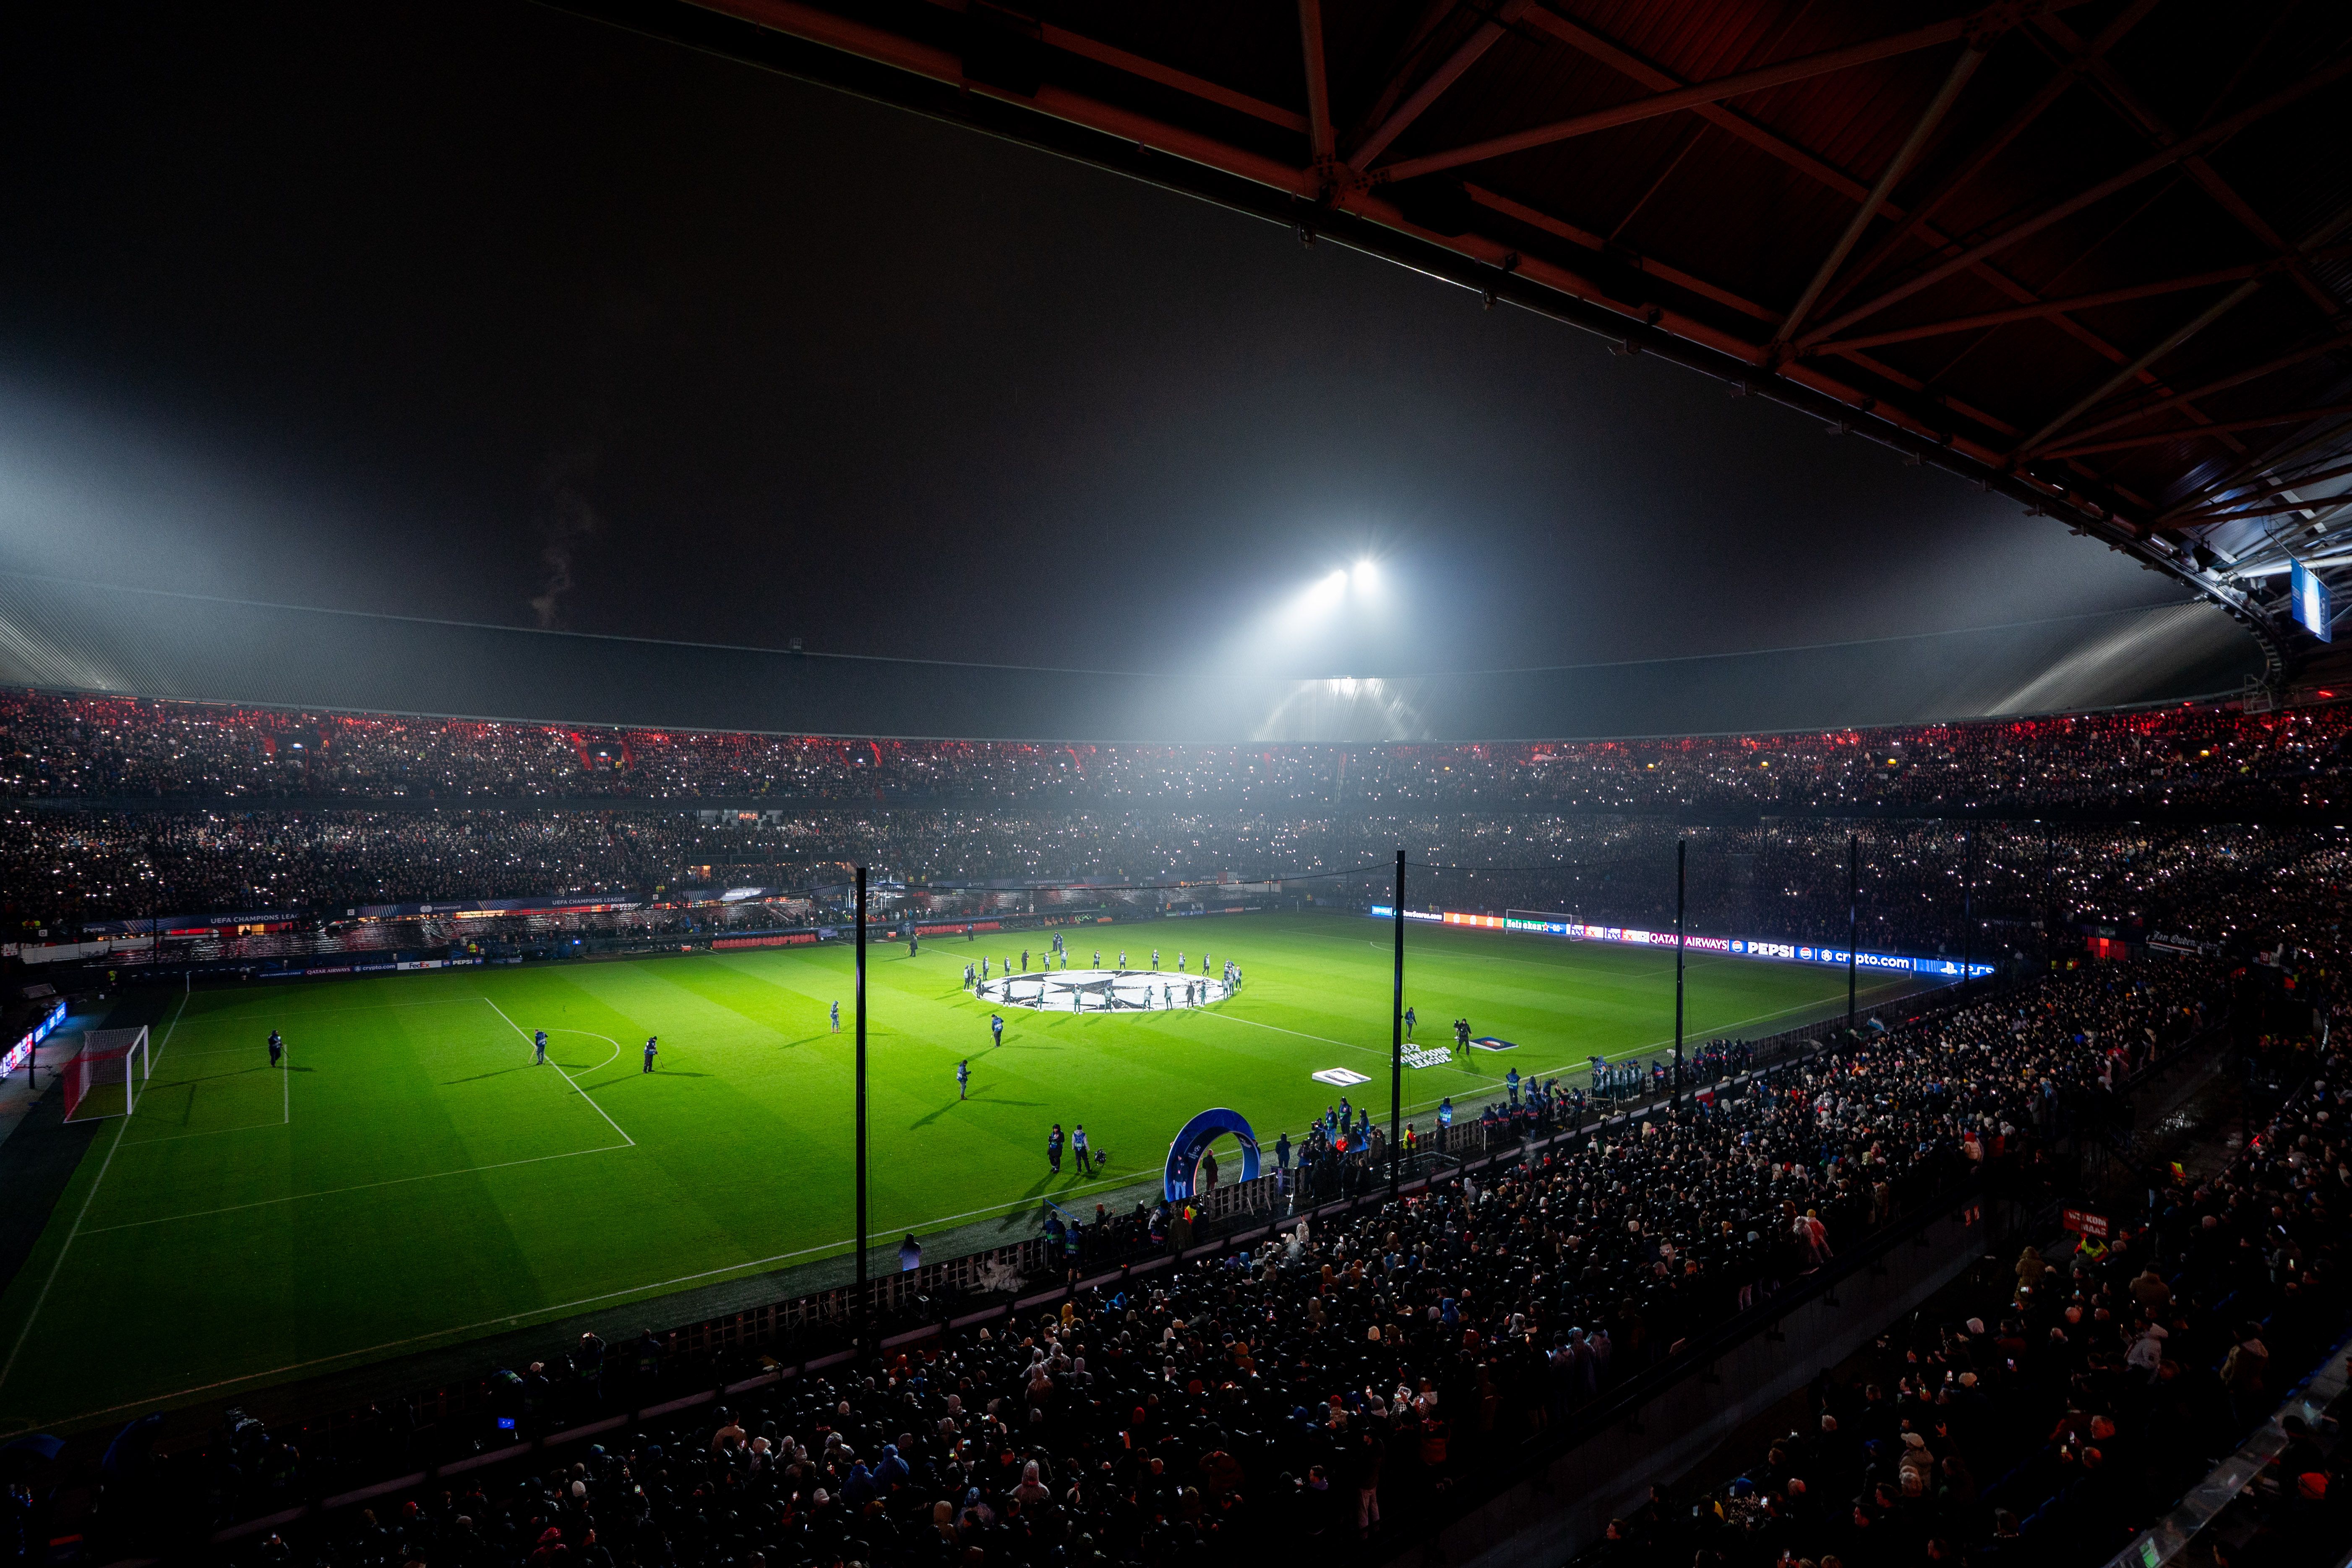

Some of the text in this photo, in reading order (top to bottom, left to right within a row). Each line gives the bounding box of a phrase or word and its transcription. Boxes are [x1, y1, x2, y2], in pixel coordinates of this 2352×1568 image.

[1507, 919, 1542, 931] Heineken
[1572, 925, 1595, 937] FedEx
[1607, 928, 1633, 941] FedEx
[2151, 930, 2168, 942] Jan
[1685, 937, 1727, 950] AIRWAYS
[1748, 942, 1794, 958] PEPSI
[1835, 952, 1909, 968] crpto.com
[1391, 1046, 1451, 1064] HAMPIONS
[1401, 1045, 1421, 1054] UEFA
[1410, 1054, 1452, 1069] LEAGUE
[2068, 1211, 2107, 1227] WELKOM
[2081, 1223, 2107, 1236] MAAS
